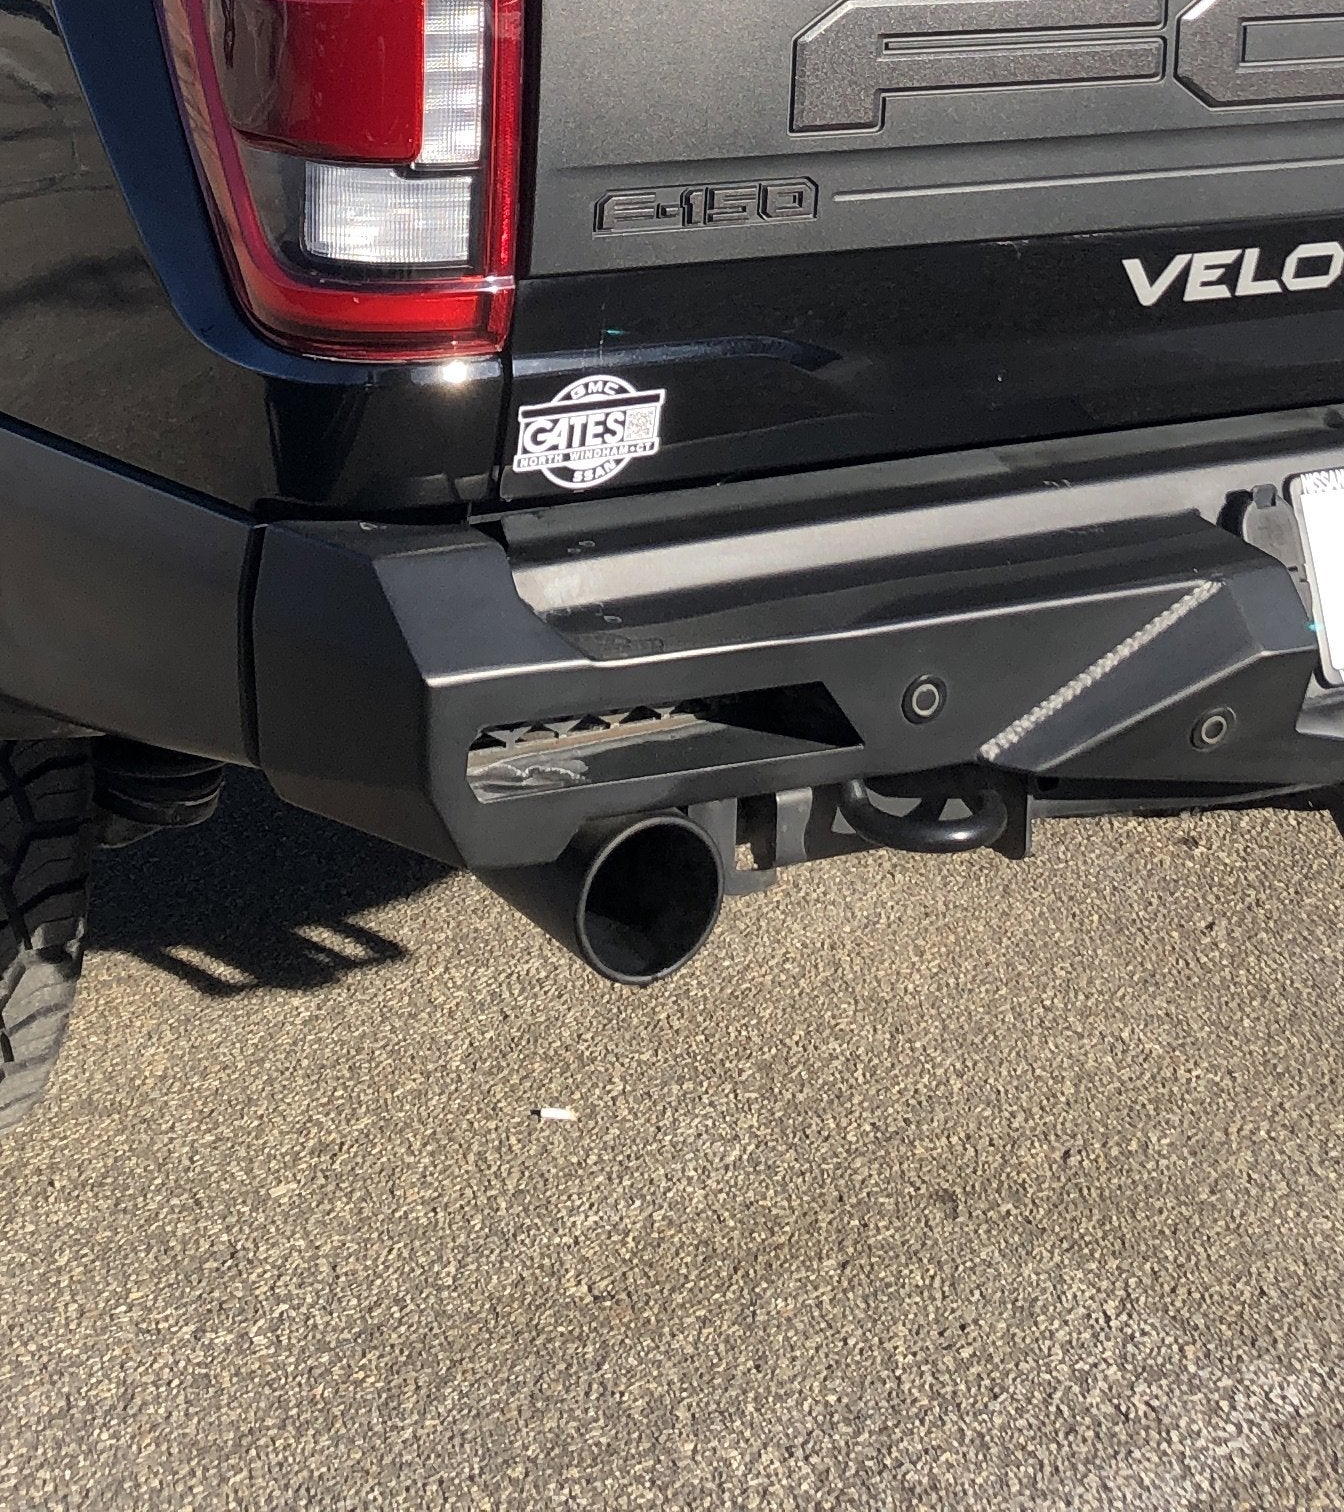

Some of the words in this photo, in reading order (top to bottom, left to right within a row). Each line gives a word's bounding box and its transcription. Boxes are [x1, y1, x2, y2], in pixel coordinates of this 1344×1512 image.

[592, 175, 819, 238] F-150
[570, 380, 619, 400] GMC
[523, 410, 625, 454] GATES
[519, 453, 563, 468] NORTH
